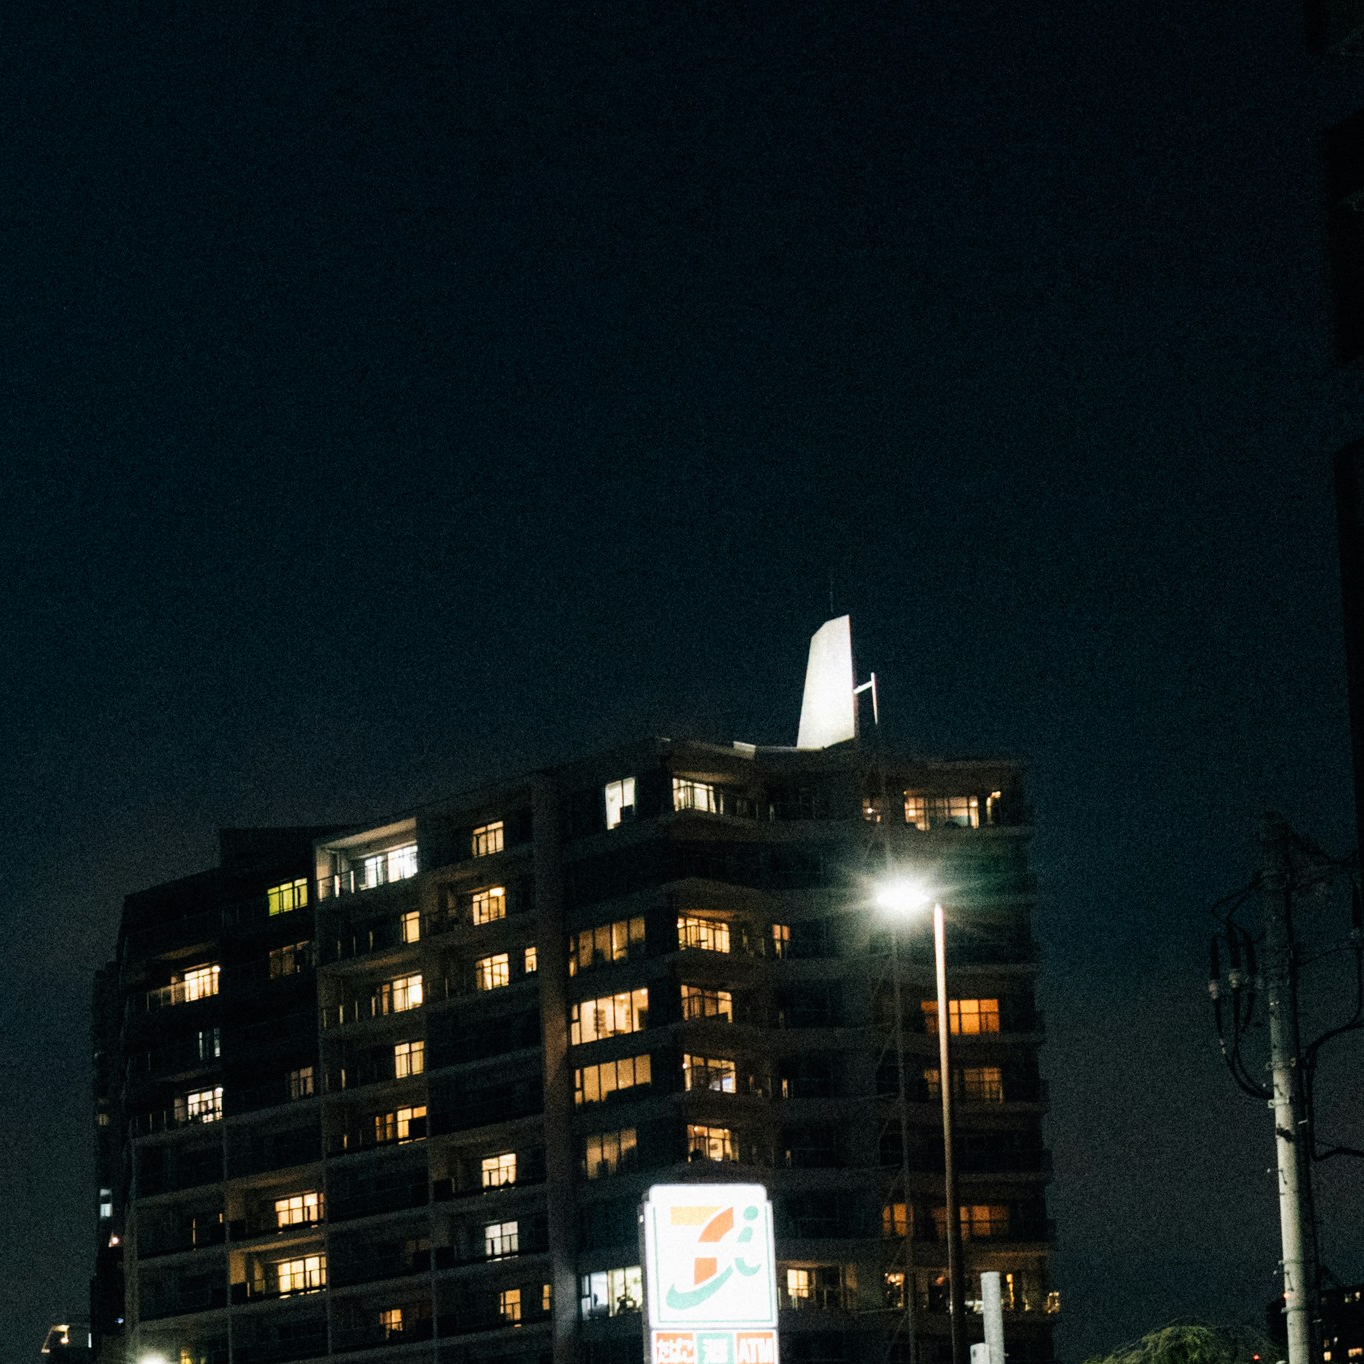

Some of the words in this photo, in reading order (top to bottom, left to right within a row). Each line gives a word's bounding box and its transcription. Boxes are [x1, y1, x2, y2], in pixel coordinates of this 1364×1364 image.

[656, 1338, 695, 1364] たばこ
[738, 1337, 774, 1364] ATM
